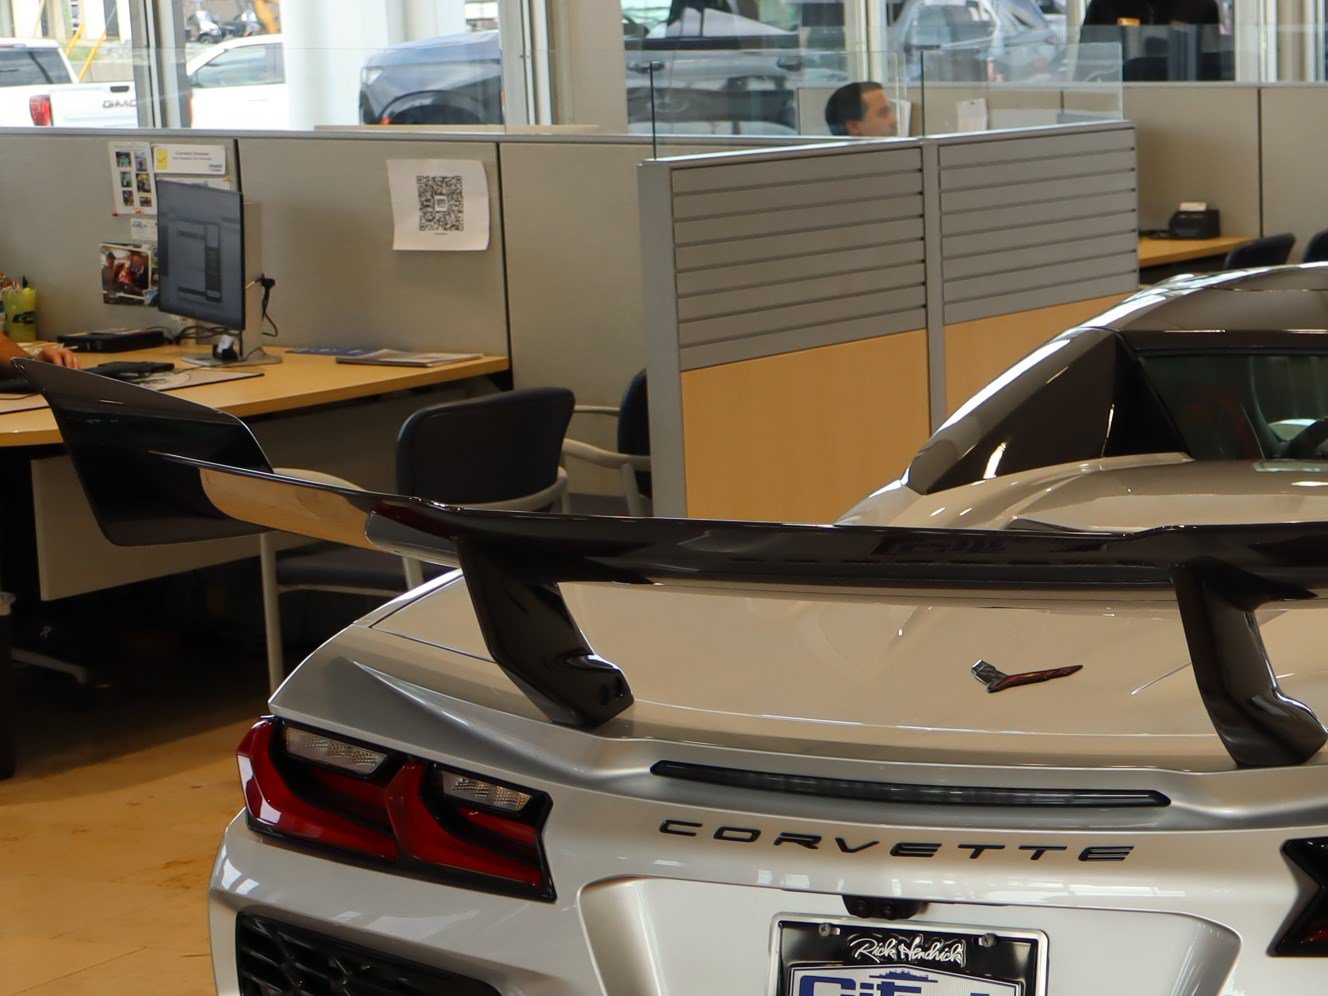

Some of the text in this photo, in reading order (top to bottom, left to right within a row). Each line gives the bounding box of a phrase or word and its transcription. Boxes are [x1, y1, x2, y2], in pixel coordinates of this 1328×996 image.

[658, 819, 1135, 862] CORVETTE
[850, 936, 963, 964] Rick Hendrick
